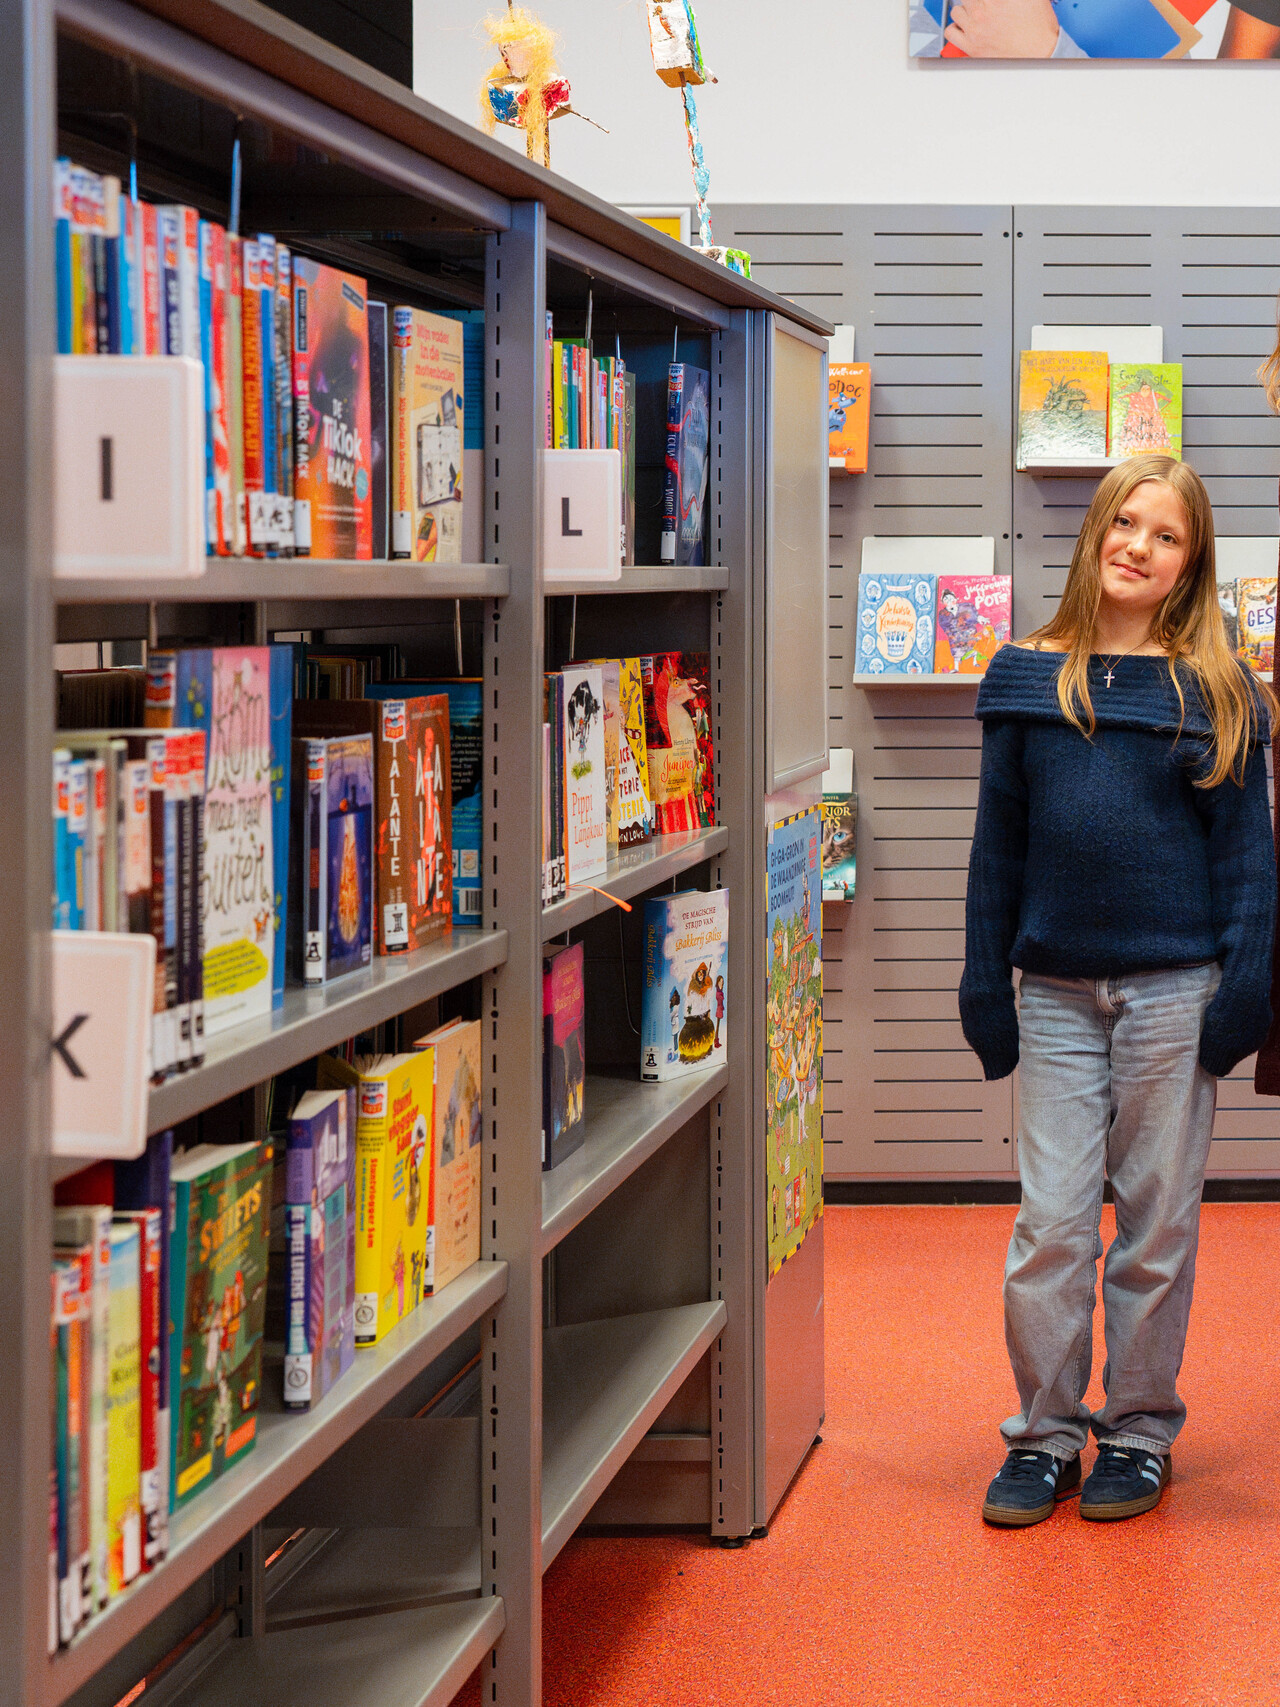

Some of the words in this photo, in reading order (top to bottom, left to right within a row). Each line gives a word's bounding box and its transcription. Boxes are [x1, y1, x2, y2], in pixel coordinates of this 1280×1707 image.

[322, 415, 362, 462] TikTok
[327, 455, 355, 488] HACK
[561, 497, 583, 536] L
[661, 754, 695, 783] Juniper
[571, 785, 593, 824] Pippi
[573, 817, 604, 848] Langkous
[682, 912, 689, 920] DE
[690, 906, 716, 918] MAGISCHE
[675, 932, 704, 952] Bakkerij
[705, 926, 722, 944] Bliss
[368, 1158, 378, 1225] Stuntvlogger
[367, 1227, 376, 1248] Sam
